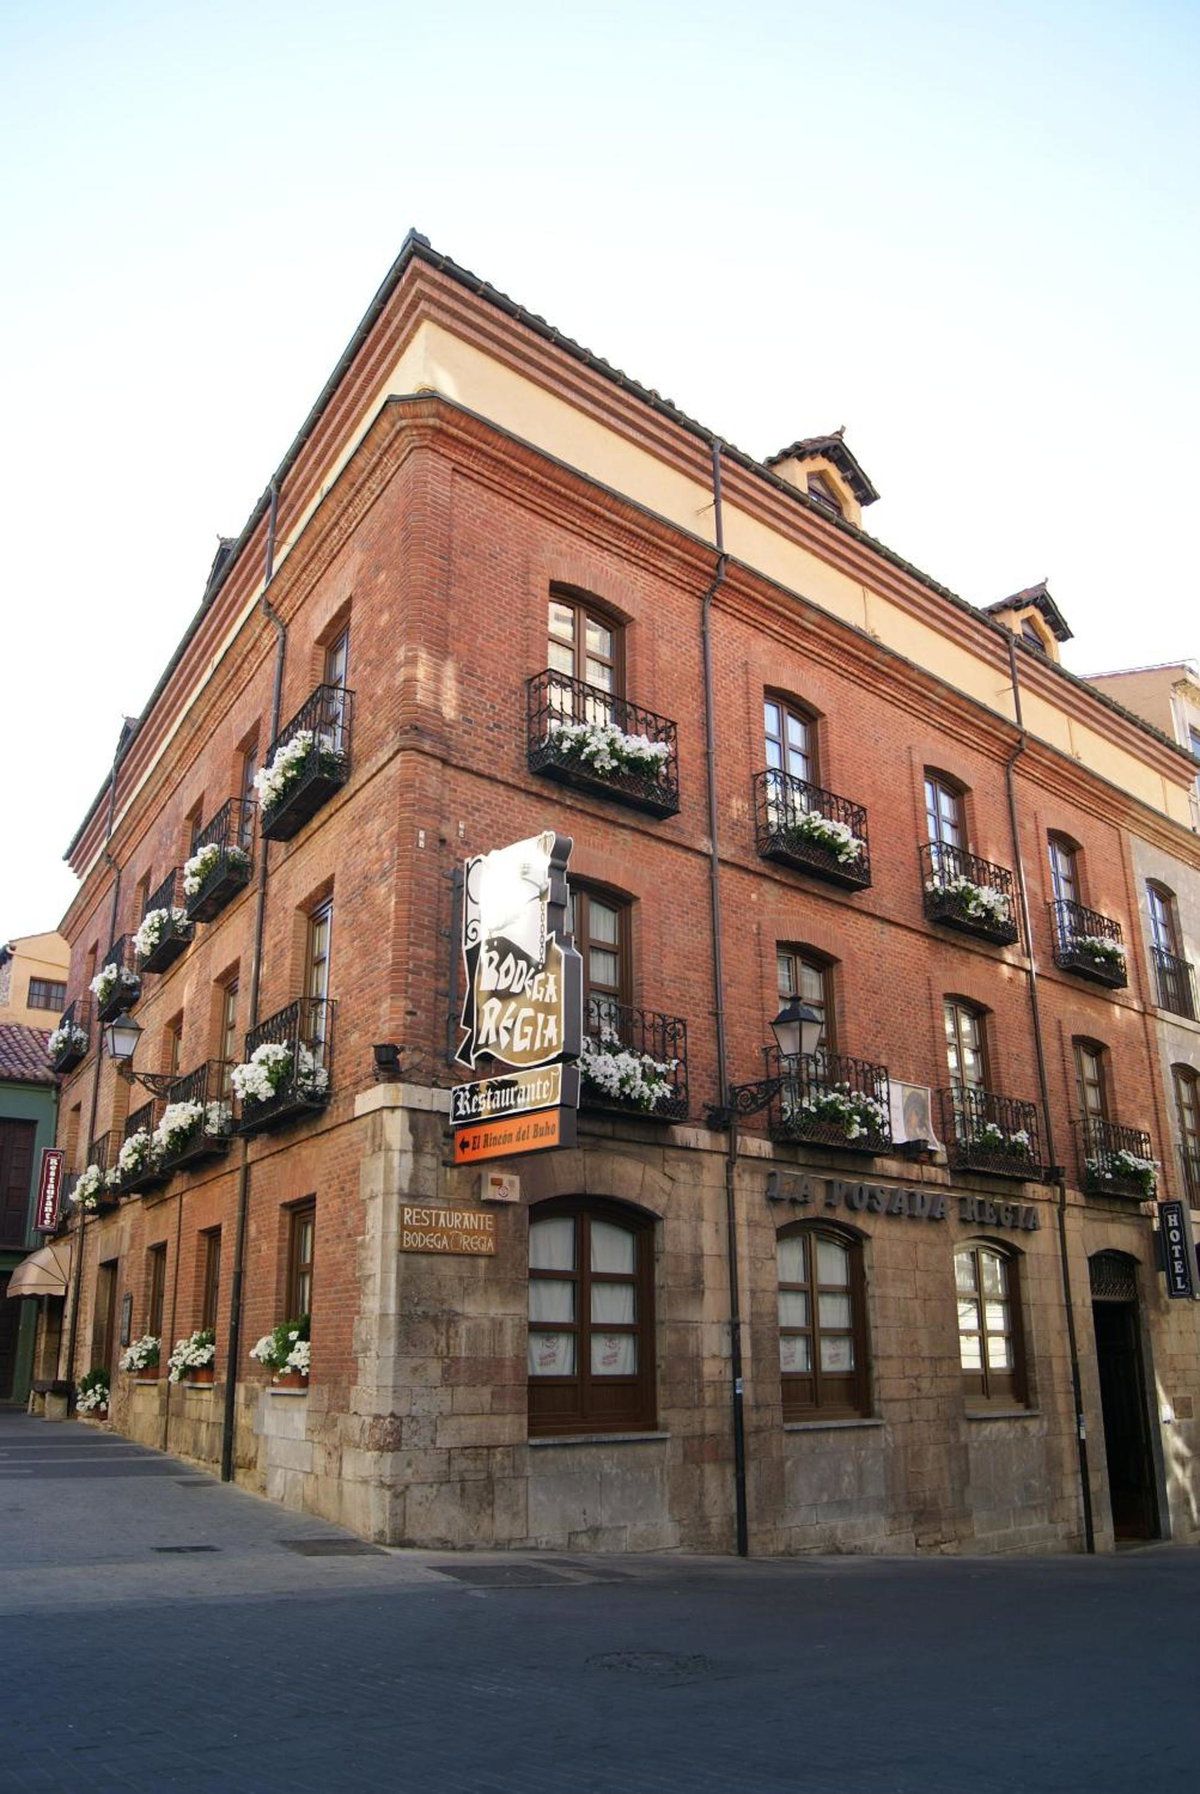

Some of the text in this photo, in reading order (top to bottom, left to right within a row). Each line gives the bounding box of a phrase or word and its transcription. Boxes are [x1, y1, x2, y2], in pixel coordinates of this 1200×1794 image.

[479, 950, 558, 1003] BODEGA
[477, 997, 558, 1052] REGIA
[455, 1078, 551, 1117] Restaurante
[471, 1134, 481, 1151] El
[482, 1129, 514, 1149] Rincón
[516, 1125, 531, 1142] del
[403, 1206, 495, 1231] RESTAURANTE
[766, 1170, 1041, 1231] LA POSADA REGIA
[402, 1230, 495, 1252] BODEGA REGIA
[1166, 1213, 1187, 1290] HOTEL
